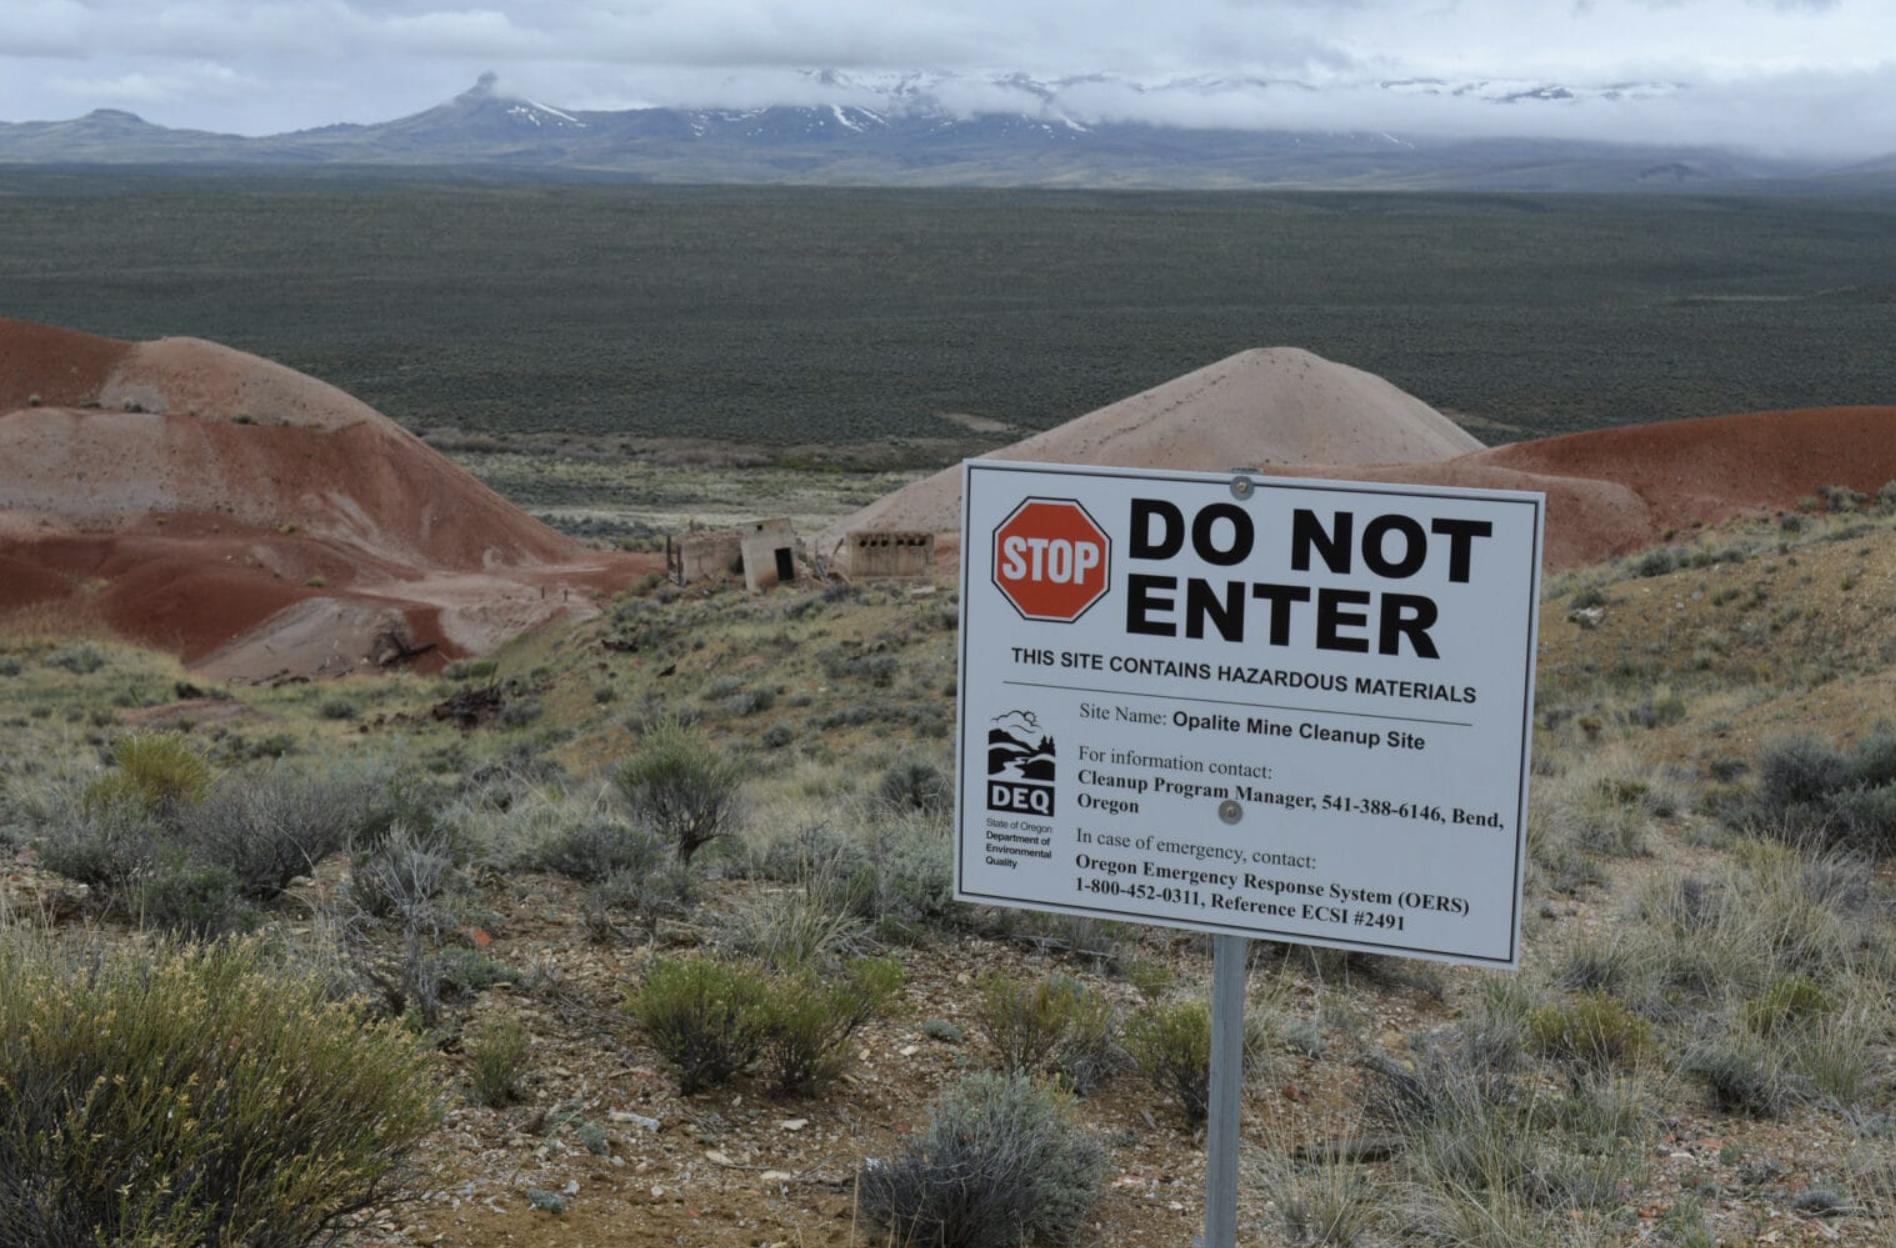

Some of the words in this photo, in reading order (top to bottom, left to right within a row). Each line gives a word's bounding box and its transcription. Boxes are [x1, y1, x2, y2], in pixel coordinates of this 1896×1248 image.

[1002, 536, 1099, 584] STOP
[1129, 497, 1254, 565] DO
[1291, 508, 1492, 582] NOT
[1126, 573, 1440, 659] ENTER
[1012, 647, 1054, 666] THIS
[1061, 652, 1103, 670] SITE
[1110, 656, 1211, 679] CONTAINS
[1218, 665, 1347, 692] HAZARDOUS
[1355, 676, 1476, 703] MATERIALS
[1080, 703, 1110, 720] Site
[1116, 706, 1166, 725] Name:
[1173, 711, 1240, 732] Opalite
[1247, 718, 1292, 736] Mine
[1300, 723, 1380, 748] Cleanup
[1387, 731, 1425, 749] Site
[1079, 746, 1104, 762] For
[1111, 748, 1203, 772] information
[1209, 761, 1272, 779] contact:
[993, 785, 1049, 814] DEQ
[1077, 794, 1139, 813] Oregon
[1078, 770, 1148, 791] Cleanup
[1155, 777, 1228, 800] Program
[1235, 785, 1316, 810] Manager,
[1322, 795, 1446, 824] 541-388-6146,
[1453, 808, 1504, 831] Bend,
[986, 818, 1008, 828] State
[1010, 821, 1019, 829] of
[1020, 821, 1052, 834] Oregon
[986, 830, 1039, 845] Department
[1041, 837, 1050, 846] of
[986, 843, 1051, 858] Environmental
[986, 856, 1017, 869] Quality
[1076, 828, 1091, 843] In
[1097, 834, 1130, 848] case
[1136, 836, 1153, 849] of
[1157, 843, 1247, 864] emergency,
[1253, 849, 1316, 869] contact:
[1076, 854, 1137, 875] Oregon
[1143, 862, 1237, 889] Emergency
[1244, 873, 1324, 897] Response
[1330, 884, 1392, 906] System
[1398, 891, 1469, 916] (OERS)
[1076, 877, 1205, 907] 1-800-452-0311,
[1211, 893, 1296, 917] Reference
[1302, 904, 1348, 924] ECSI
[1354, 911, 1404, 931] #2491
